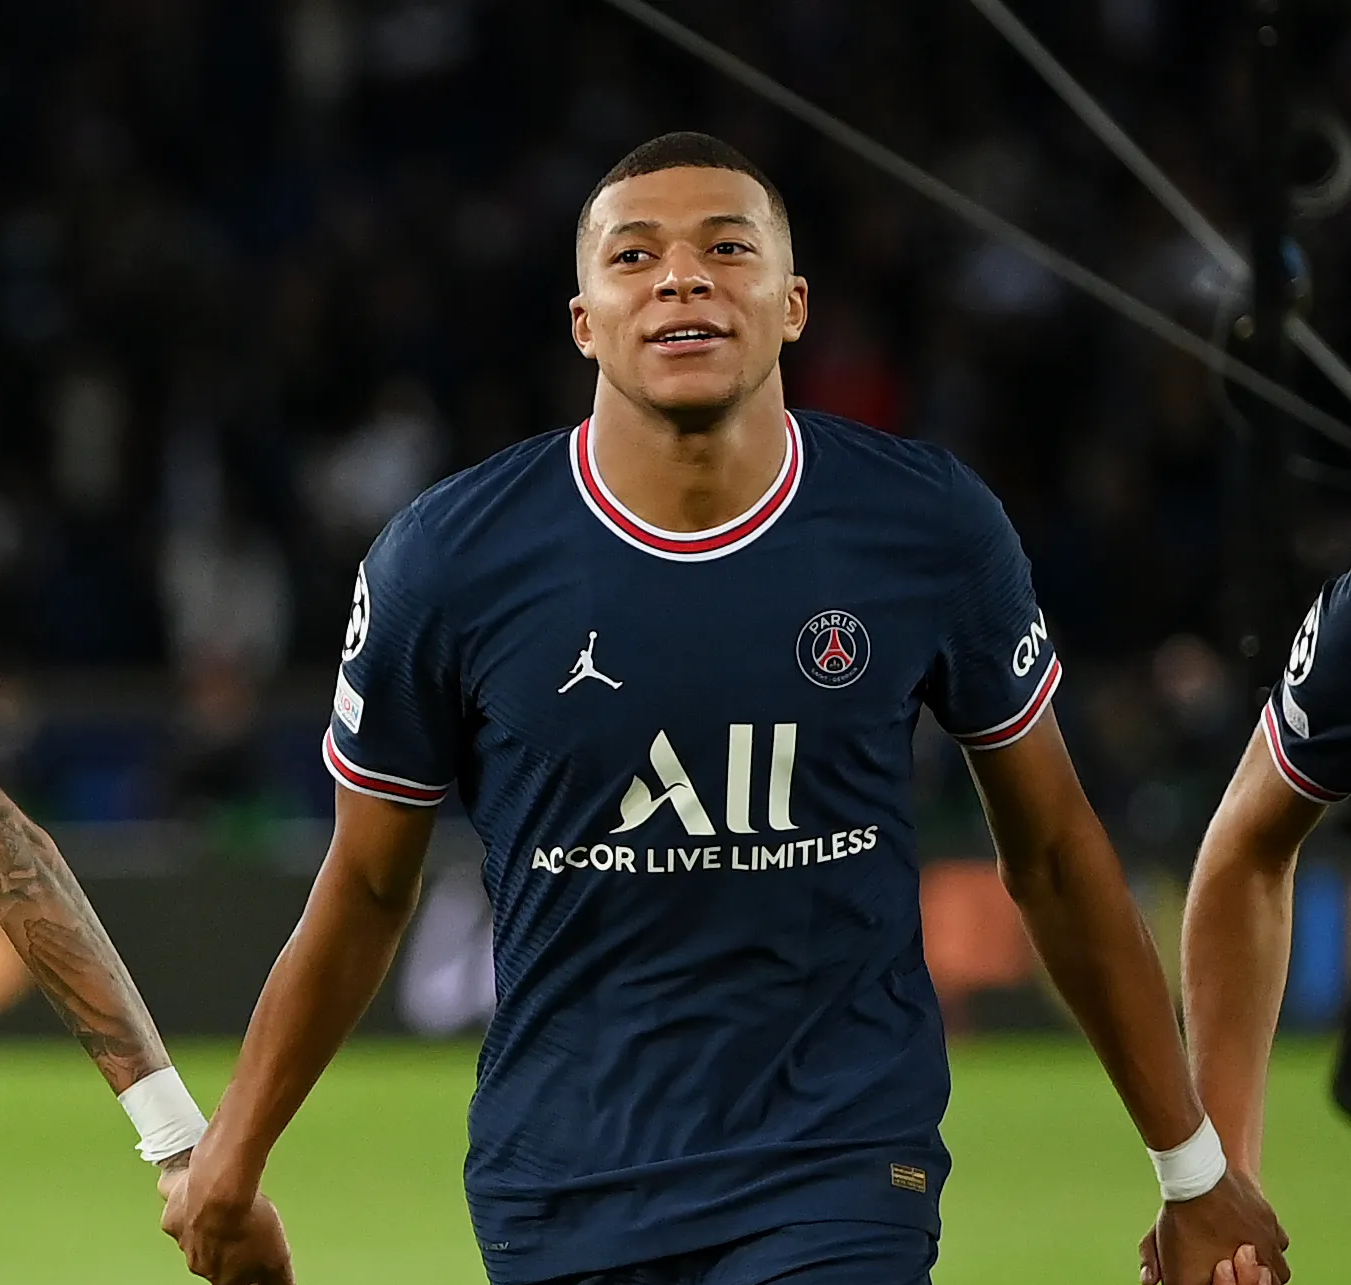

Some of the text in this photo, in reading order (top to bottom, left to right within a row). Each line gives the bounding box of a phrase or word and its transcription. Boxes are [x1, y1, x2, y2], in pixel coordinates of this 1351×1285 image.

[808, 614, 858, 635] PARIS
[1011, 606, 1048, 678] QN
[531, 825, 879, 875] ACCOR LIVE LIMITLESS
